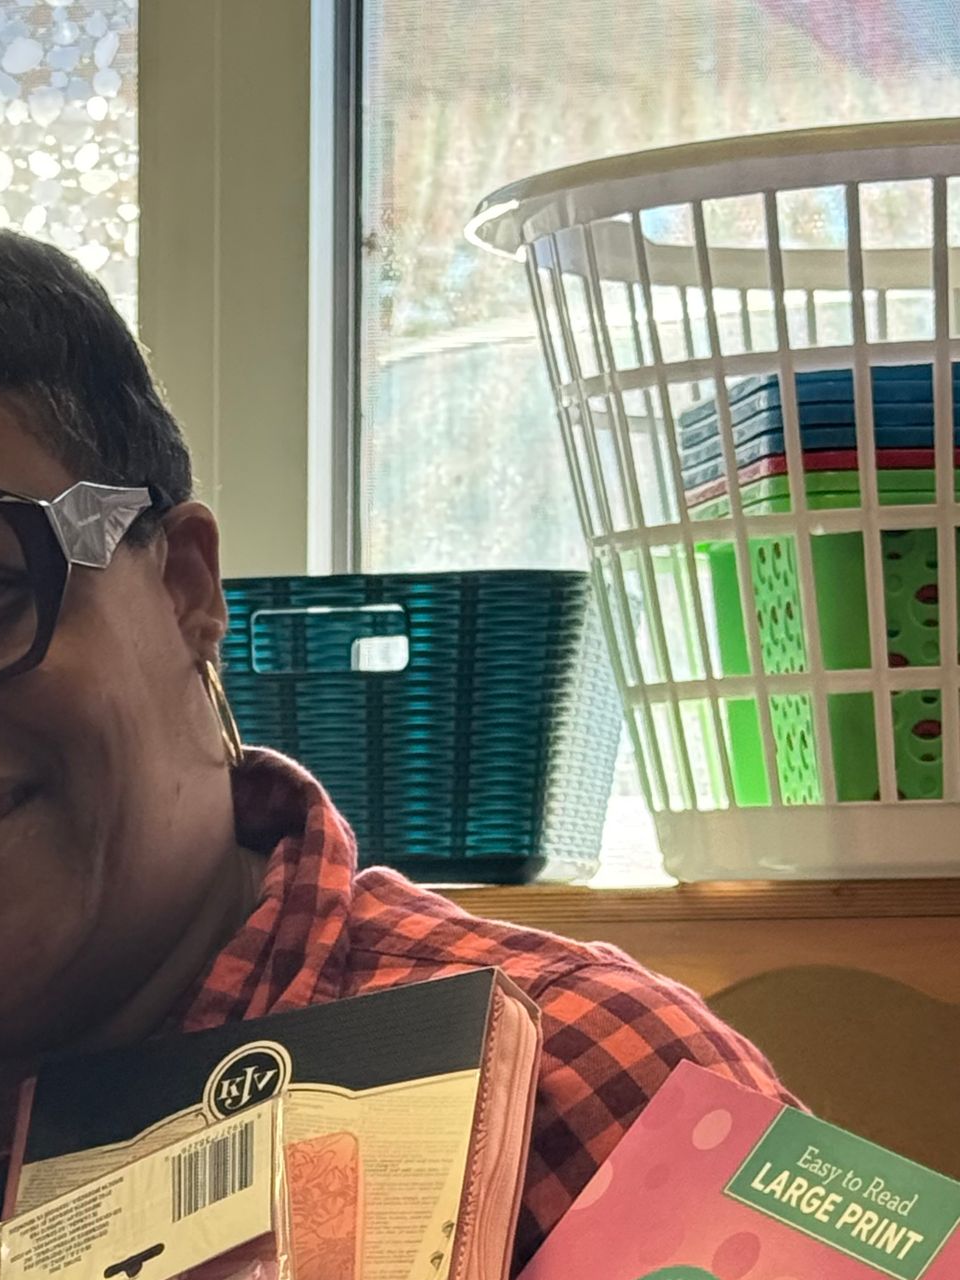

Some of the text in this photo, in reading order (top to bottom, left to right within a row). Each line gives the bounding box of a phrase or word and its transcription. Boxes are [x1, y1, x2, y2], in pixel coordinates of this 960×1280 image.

[217, 1065, 278, 1110] KJV
[750, 1161, 925, 1261] LARGE PRINT
[796, 1145, 919, 1217] Easy to Read
